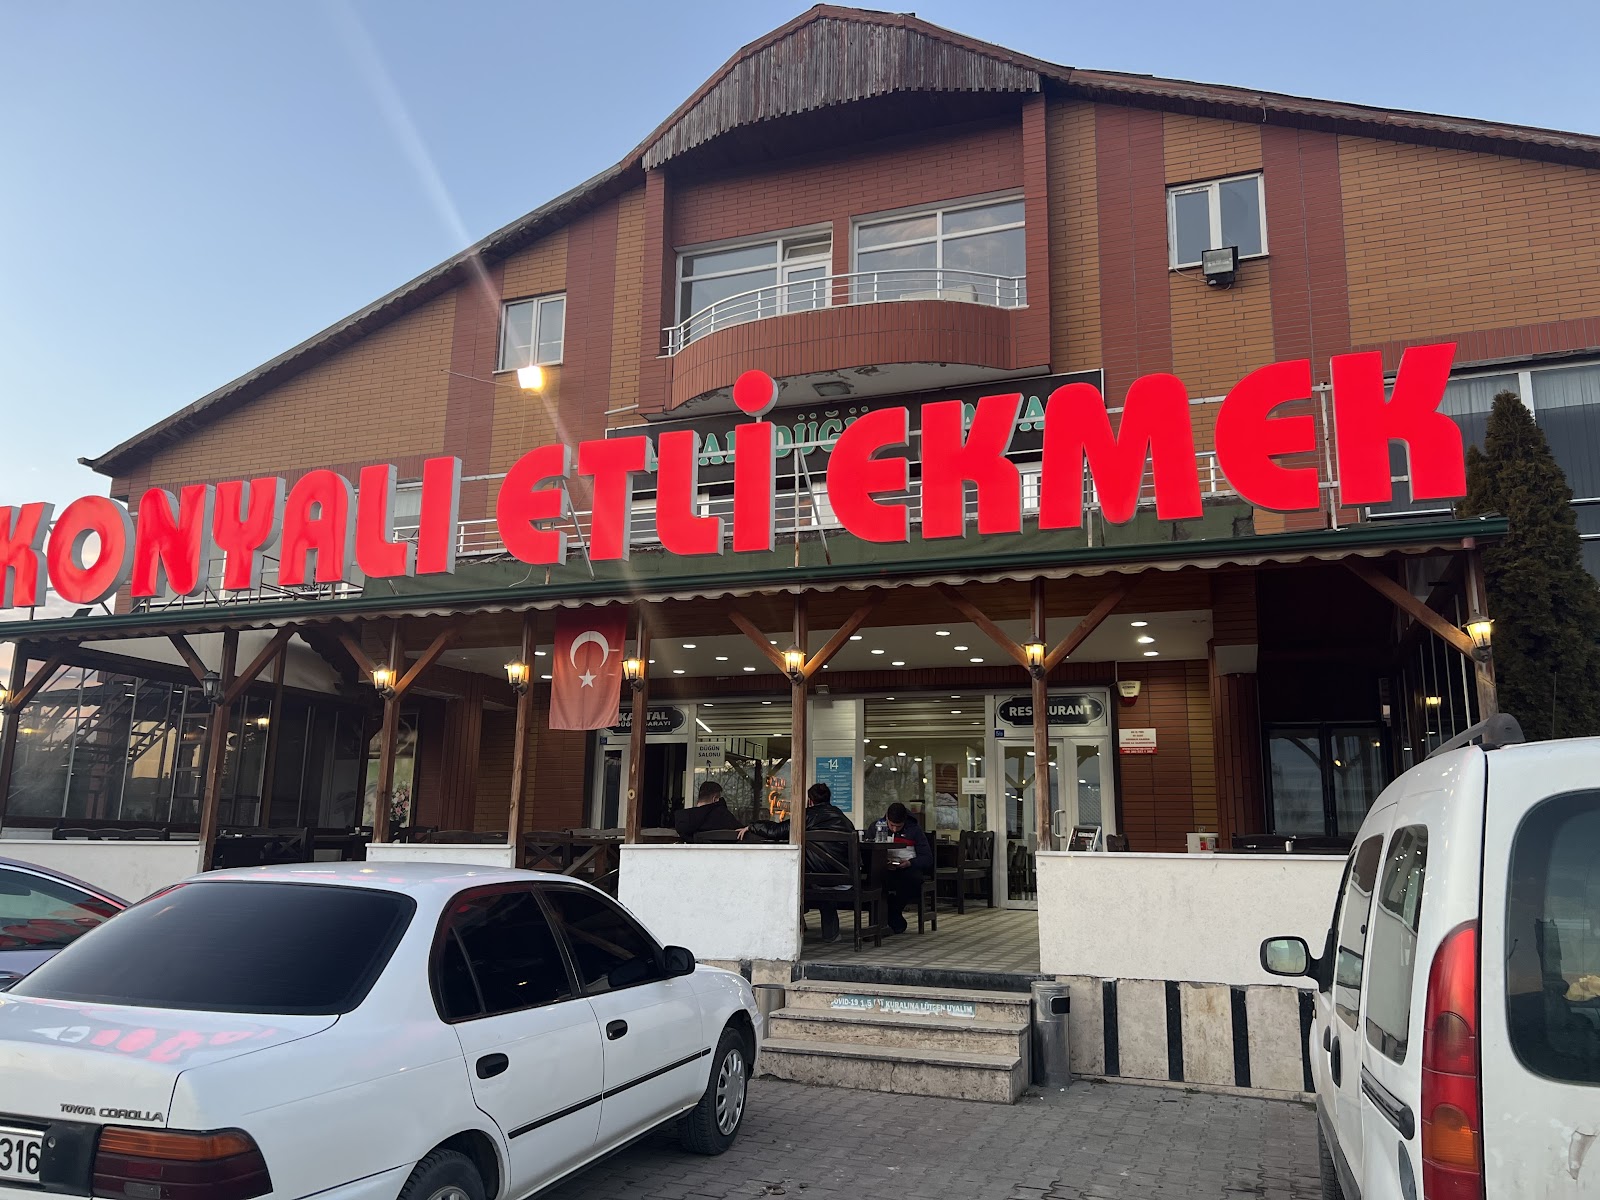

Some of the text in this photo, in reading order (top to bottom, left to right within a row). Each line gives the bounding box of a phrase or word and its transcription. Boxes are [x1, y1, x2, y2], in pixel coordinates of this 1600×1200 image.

[0, 456, 462, 609] KONYALI
[827, 342, 1467, 544] EKMEK
[619, 711, 668, 721] KATAL
[1009, 704, 1092, 717] RESURANT
[827, 758, 839, 770] 14
[885, 1000, 919, 1010] KURALINA
[60, 1103, 164, 1122] TOYOTA COROLLA
[0, 1137, 41, 1175] 316
